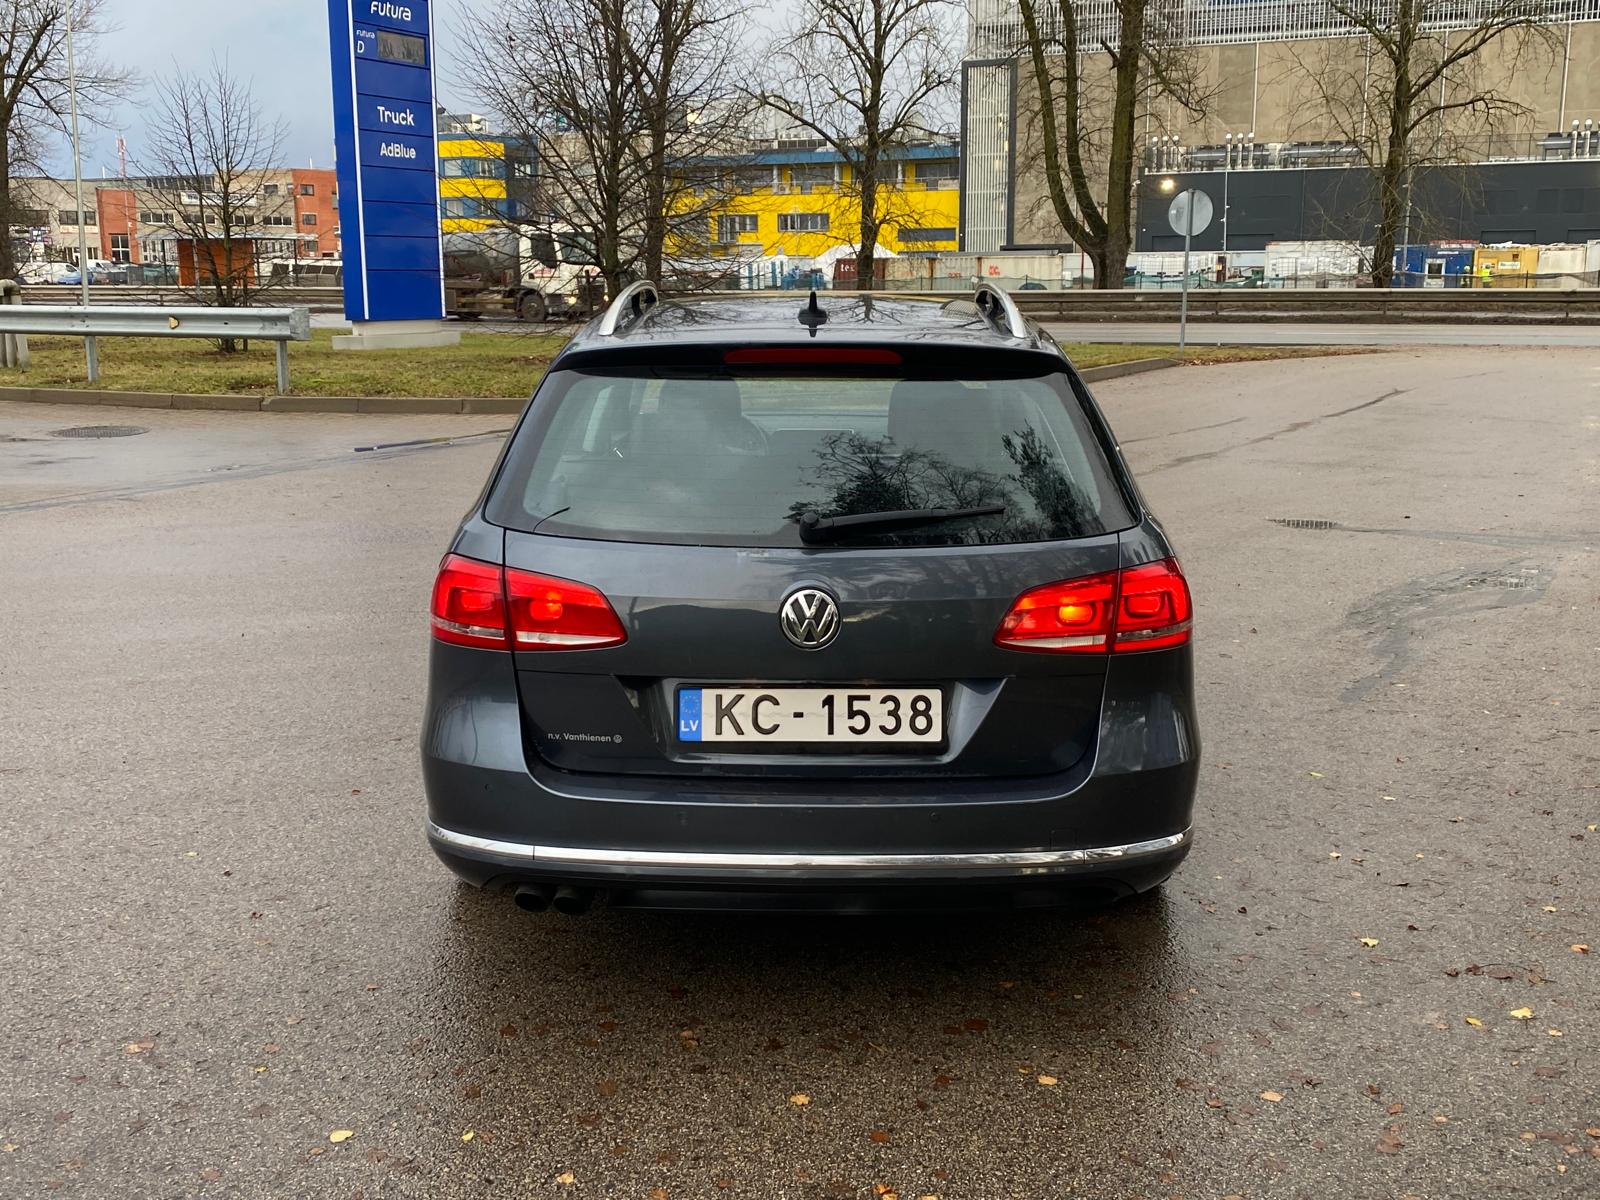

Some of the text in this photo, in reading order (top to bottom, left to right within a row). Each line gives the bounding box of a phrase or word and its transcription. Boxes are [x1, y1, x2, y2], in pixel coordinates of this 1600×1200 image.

[371, 1, 411, 21] Futura
[357, 40, 365, 53] D
[377, 106, 415, 126] Truck
[380, 142, 417, 159] AdBlue
[781, 589, 839, 648] VW
[715, 694, 933, 736] KC-1538
[680, 720, 699, 732] LV
[563, 732, 612, 742] Vanthienen
